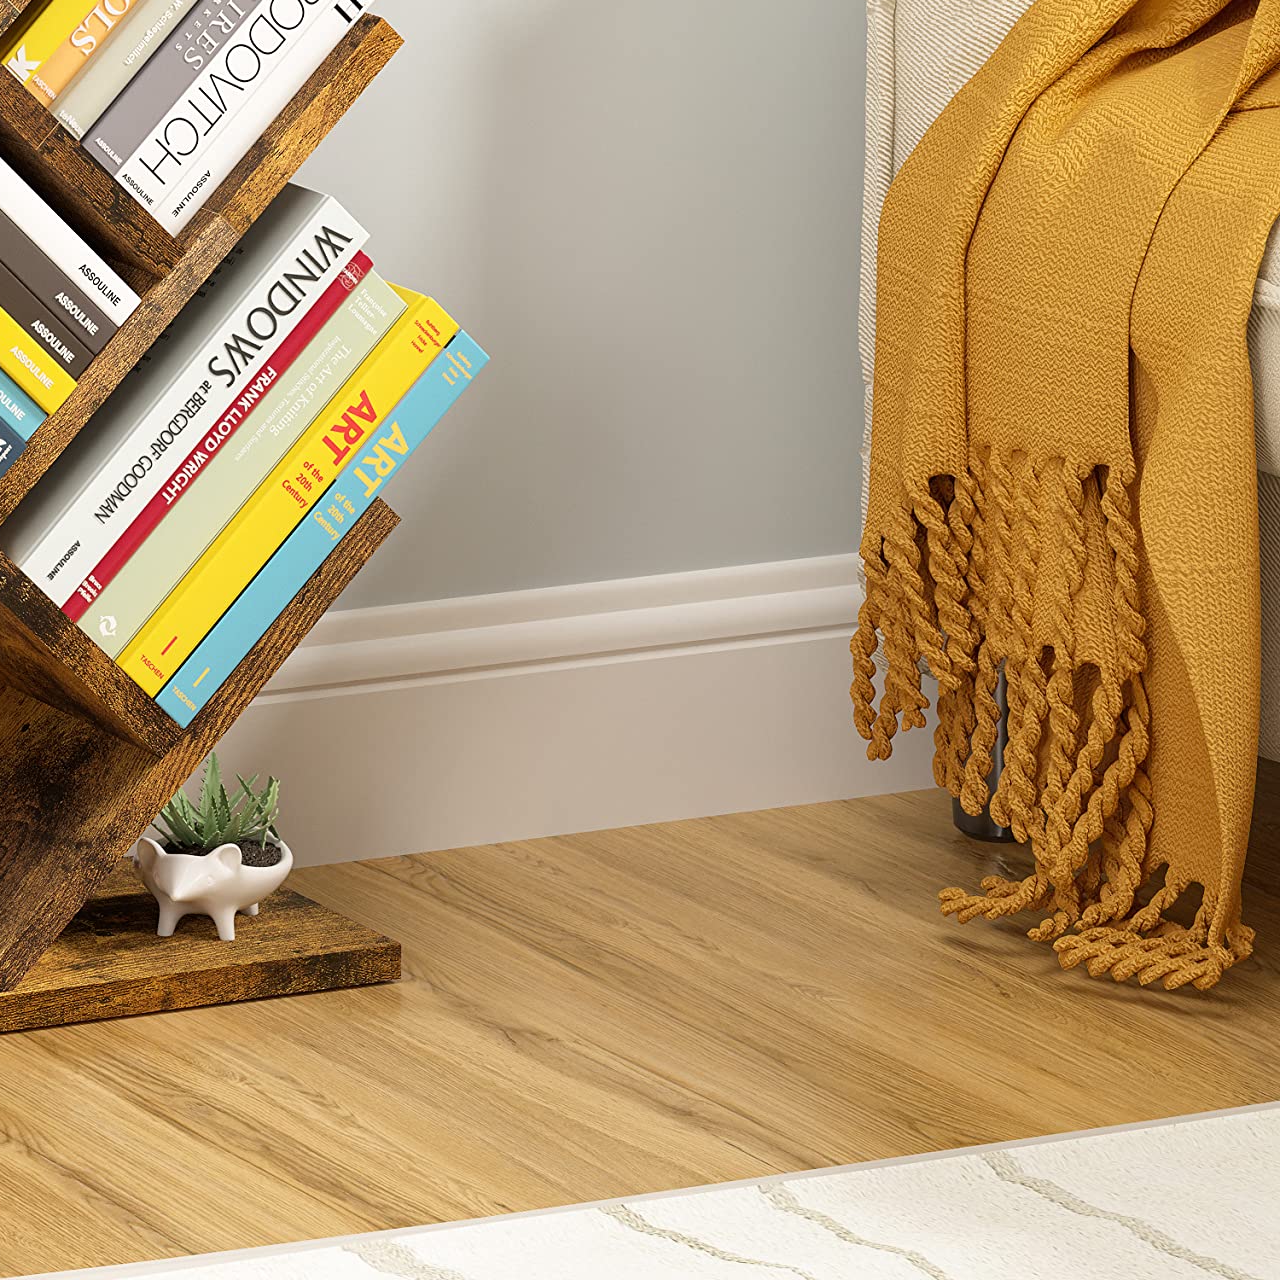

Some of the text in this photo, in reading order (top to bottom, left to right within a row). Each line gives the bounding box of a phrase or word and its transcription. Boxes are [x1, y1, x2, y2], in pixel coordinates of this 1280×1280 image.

[91, 135, 124, 165] ASSOULINE
[118, 172, 156, 206] ASSOULINE
[170, 169, 212, 217] ASSOULINE
[76, 261, 122, 308] ASSOULINE
[203, 217, 354, 389] WINDOWS
[53, 289, 100, 337] ASSOULINE
[29, 317, 75, 364] ASSOULINE
[8, 343, 54, 390] ASSOULINE
[197, 379, 213, 395] at
[268, 343, 352, 438] The Art of Knitting
[145, 390, 207, 460] BERGDORF
[158, 365, 278, 505] FRANK LLOYD WRIGHT
[314, 388, 385, 466] ART
[293, 472, 315, 492] 20th
[300, 459, 326, 483] of the
[345, 420, 417, 498] ART
[92, 453, 155, 524] GOODMAN
[277, 478, 311, 509] Century
[332, 490, 357, 515] of the
[308, 509, 343, 541] Century
[325, 503, 347, 524] 20th
[45, 539, 82, 581] ASSOULINE
[137, 654, 166, 679] TASCHEN
